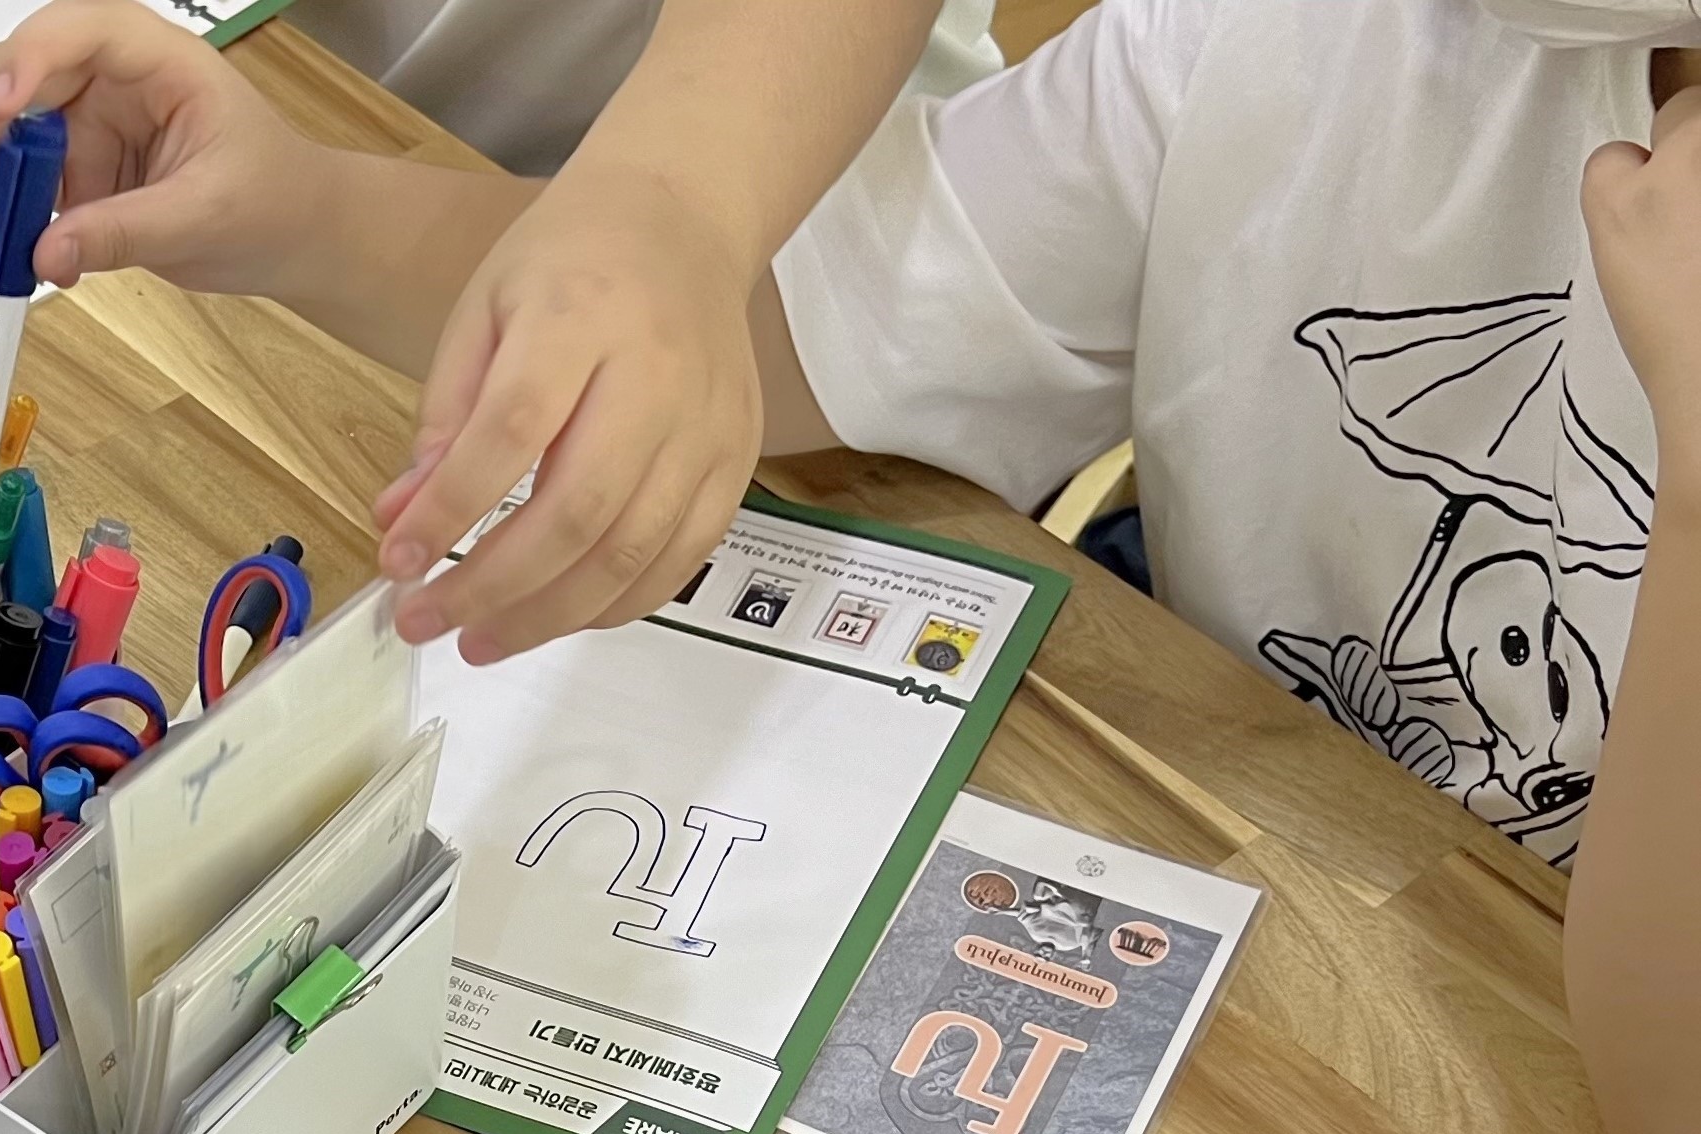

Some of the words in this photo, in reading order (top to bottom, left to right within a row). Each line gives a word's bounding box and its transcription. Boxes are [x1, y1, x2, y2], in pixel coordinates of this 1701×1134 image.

[464, 1000, 489, 1016] 나의
[529, 1020, 600, 1055] 만들기
[444, 1059, 521, 1094] 세계시민
[603, 1042, 721, 1094] 평화메세지
[523, 1084, 597, 1119] 공감하는
